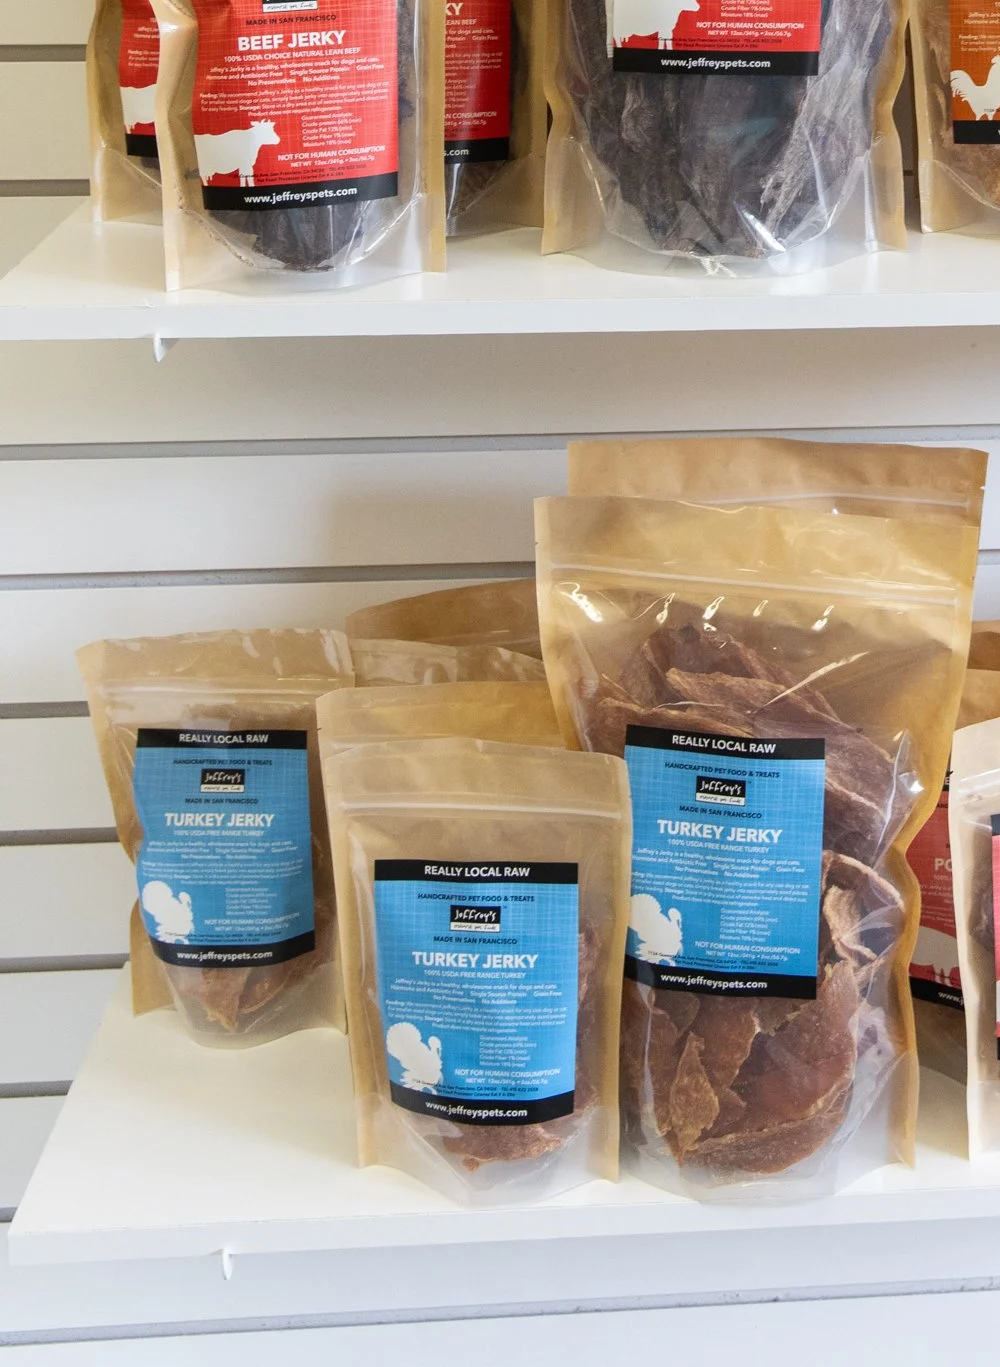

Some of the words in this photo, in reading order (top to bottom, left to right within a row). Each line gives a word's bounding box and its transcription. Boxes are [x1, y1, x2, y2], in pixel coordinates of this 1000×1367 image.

[294, 15, 336, 23] FRANCISCO
[697, 21, 710, 29] NOT
[712, 21, 726, 29] FOR
[754, 22, 804, 30] CONSUMPTION
[238, 34, 284, 51] BEEF
[287, 30, 346, 47] JERKY
[224, 55, 241, 63] 100%
[243, 53, 262, 61] USDA
[264, 51, 291, 60] CHOICE
[292, 49, 324, 58] NATURAL
[325, 48, 343, 56] LEAN
[661, 58, 770, 69] www.jeffreyspets.com
[244, 186, 357, 205] www.jeffreyspets.com
[179, 733, 211, 743] REALLY
[213, 734, 244, 743] LOCAL
[246, 735, 268, 743] RAW
[672, 735, 710, 748] REALLY
[712, 740, 747, 751] LOCAL
[749, 743, 776, 753] RAW
[205, 771, 241, 782] Jeffrey's
[700, 780, 741, 794] Jeffrey's
[165, 813, 225, 827] TURKEY
[227, 814, 275, 827] JERKY
[657, 819, 724, 838] TURKEY
[727, 827, 782, 843] JERKY
[424, 865, 462, 876] REALLY
[465, 866, 501, 876] LOCAL
[504, 867, 530, 877] RAW
[934, 858, 952, 871] PO
[418, 893, 466, 901] HANDCRAFTED
[455, 909, 496, 922] Jeffrey's
[177, 951, 272, 961] www.jeffreyspets.com
[412, 952, 480, 968] TURKEY
[482, 954, 538, 968] JERKY
[661, 973, 767, 989] www.jeffreyspets.com
[425, 1102, 527, 1118] www.jeffreyspets.com
